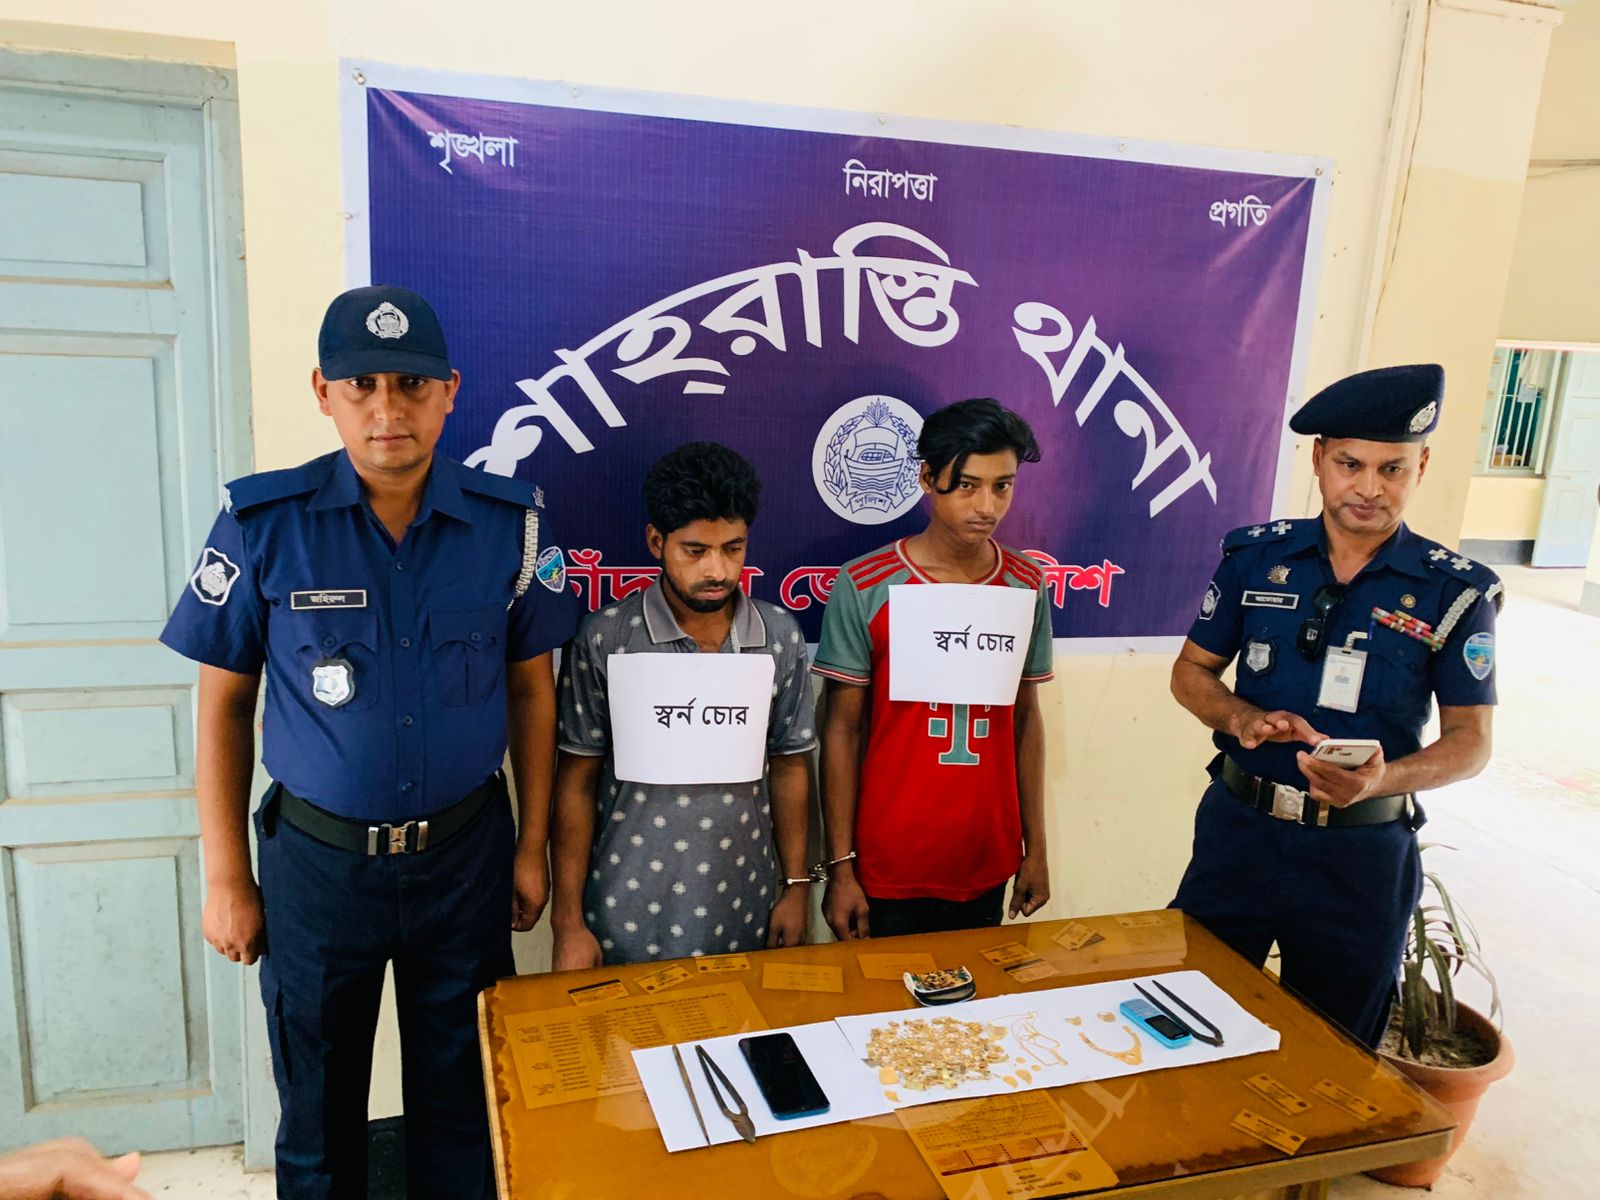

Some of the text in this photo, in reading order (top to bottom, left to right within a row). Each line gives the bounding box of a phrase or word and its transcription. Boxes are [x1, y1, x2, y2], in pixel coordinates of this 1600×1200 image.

[427, 129, 519, 175] শৃঙ্খলা
[842, 158, 938, 202] নিরাপত্তা
[1209, 194, 1272, 228] প্রগতি
[1011, 301, 1217, 519] থানা
[933, 624, 1016, 653] স্বর্ন চোর
[653, 697, 750, 729] স্বর্ন চোর
